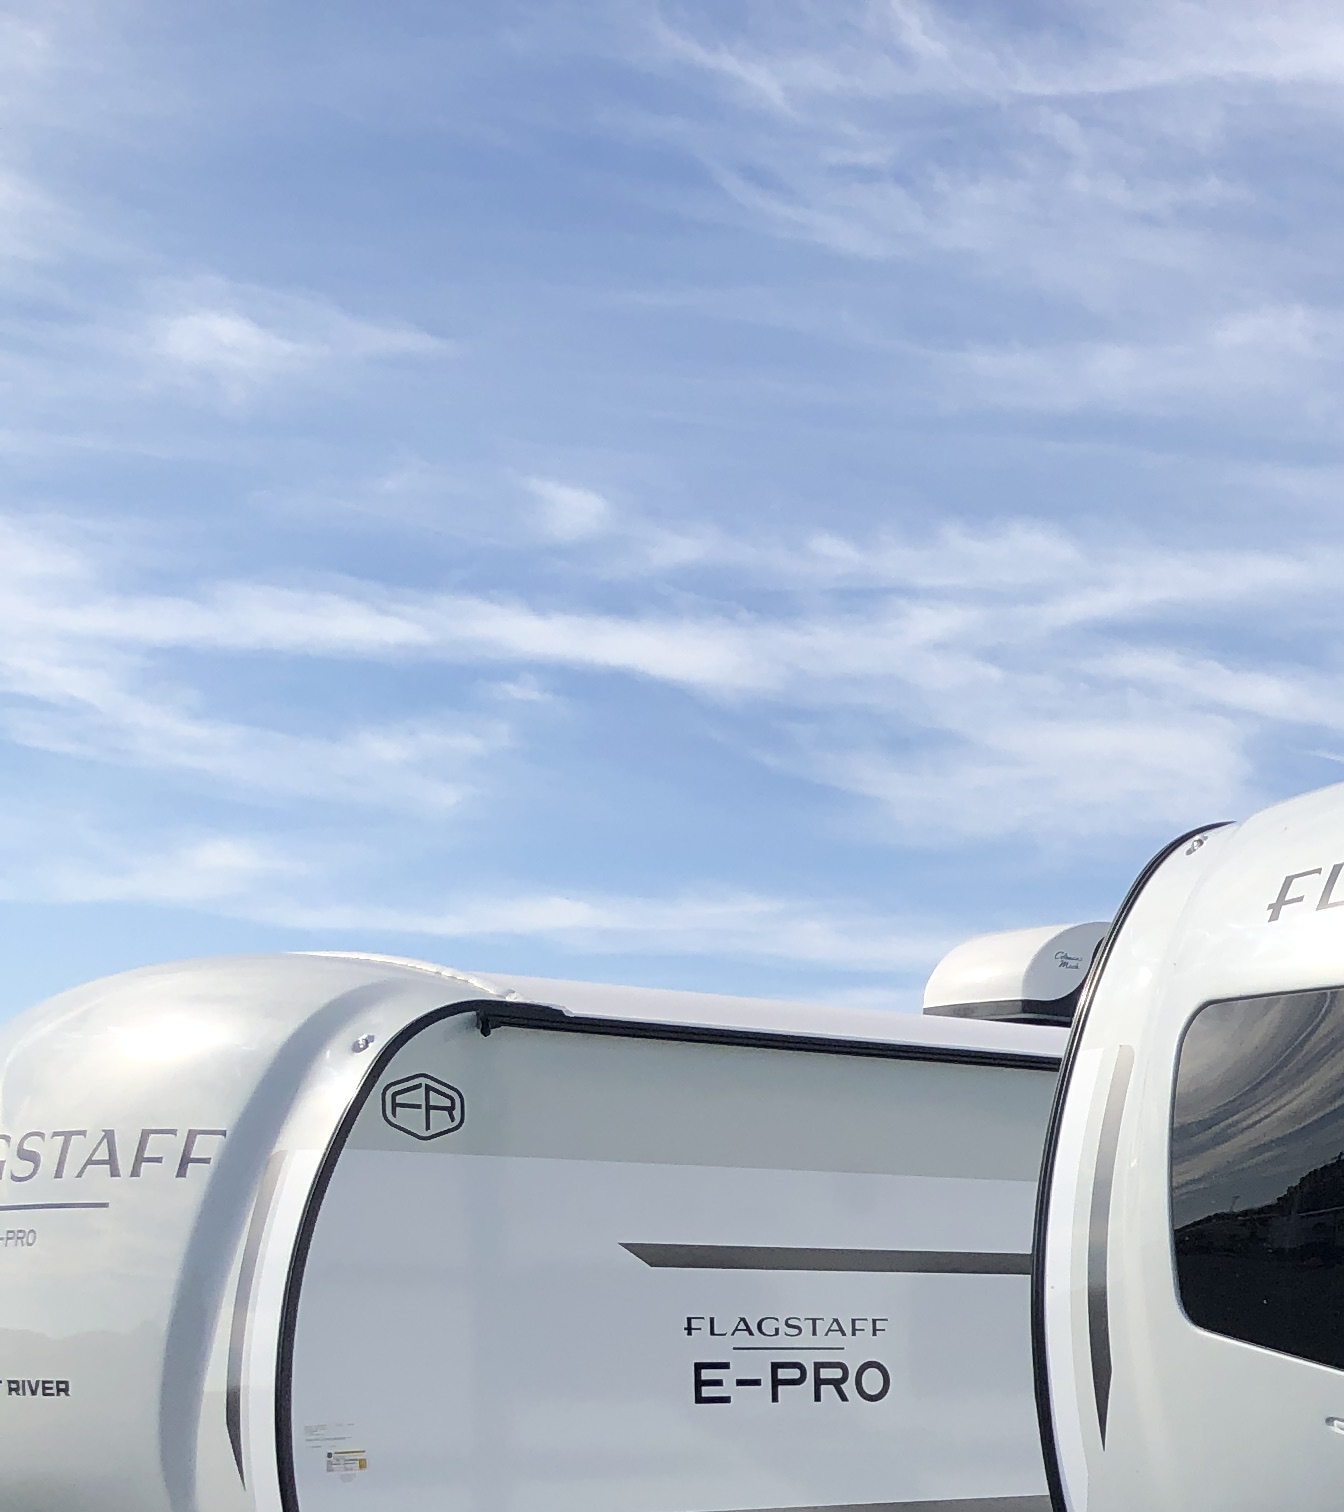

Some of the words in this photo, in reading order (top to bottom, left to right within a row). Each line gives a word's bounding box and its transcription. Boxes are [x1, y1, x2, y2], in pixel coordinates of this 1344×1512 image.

[683, 1316, 889, 1338] FLAGSTAFF
[6, 1379, 71, 1397] RIVER
[693, 1360, 891, 1405] E-PRO
